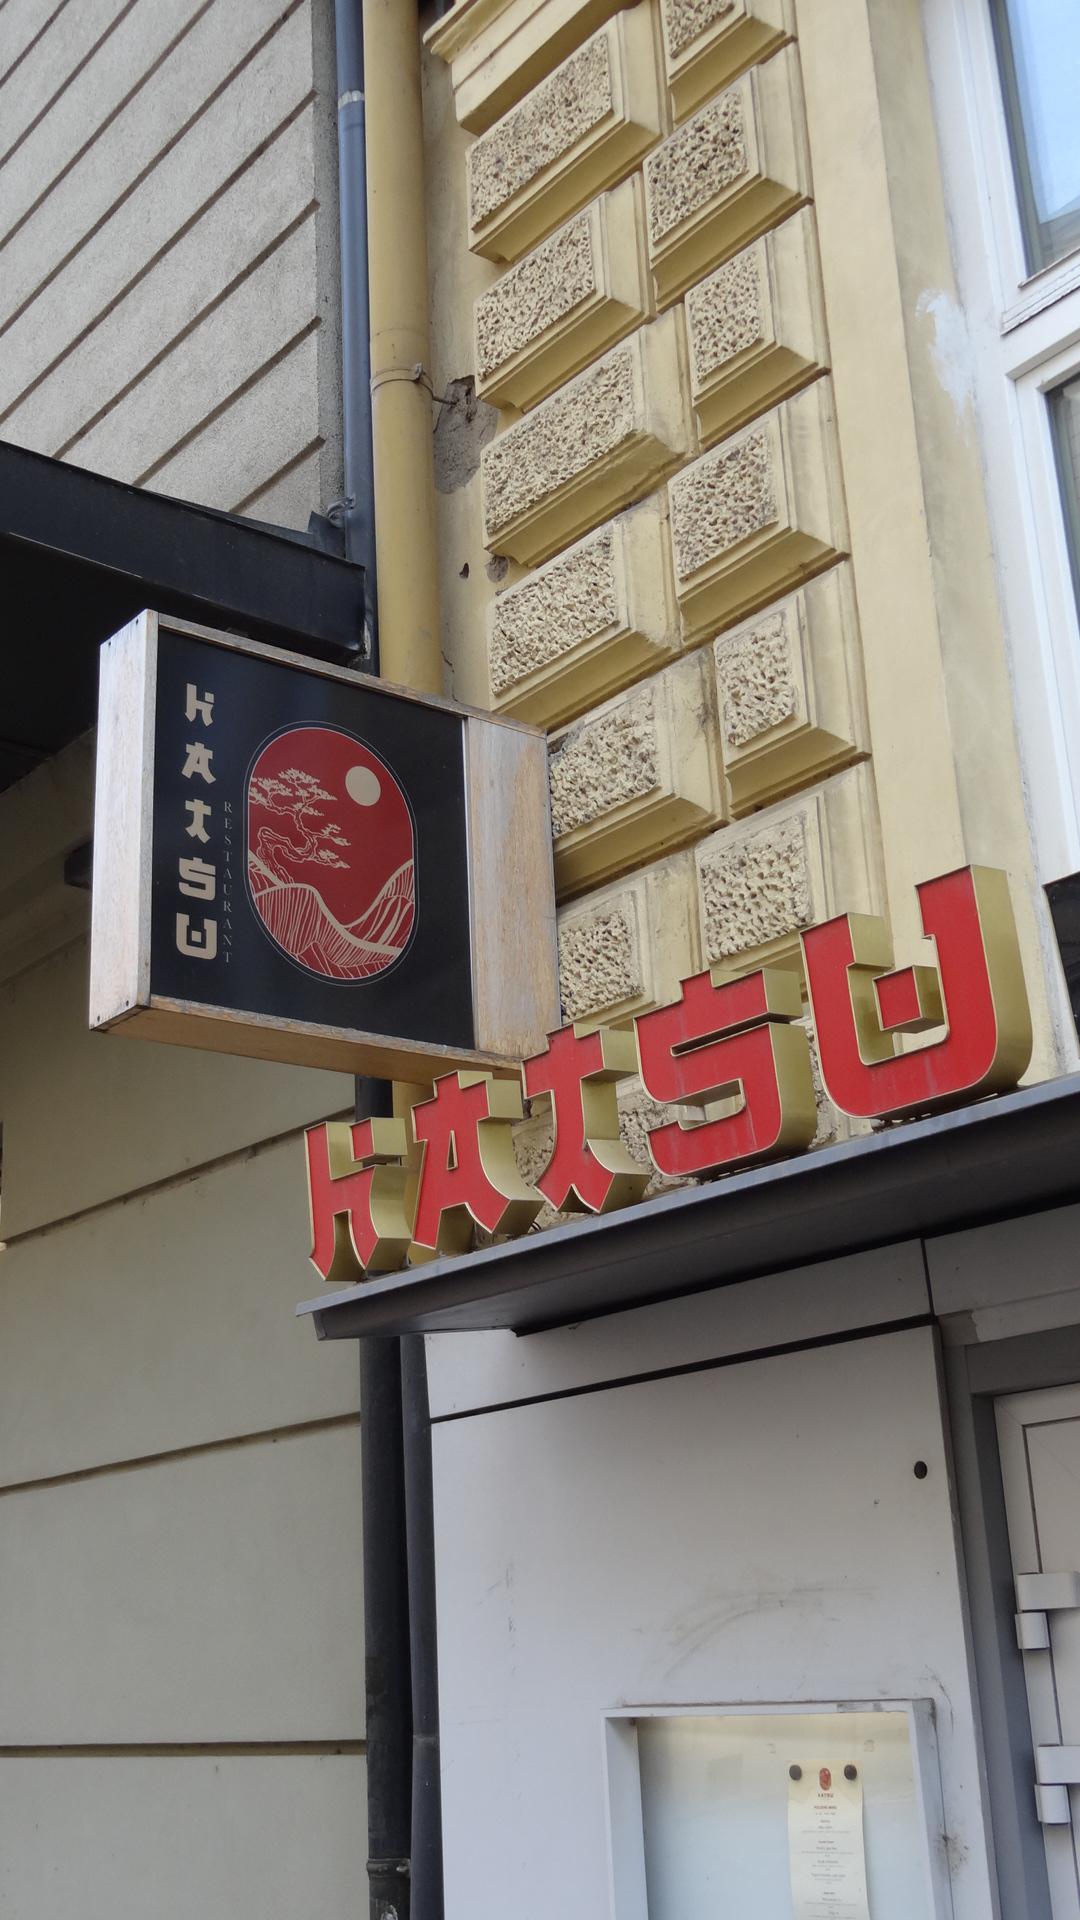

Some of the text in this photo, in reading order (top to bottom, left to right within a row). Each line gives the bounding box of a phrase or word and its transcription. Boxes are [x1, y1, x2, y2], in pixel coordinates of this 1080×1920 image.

[176, 683, 217, 960] KATSU
[223, 801, 233, 963] RESTAURANT
[304, 864, 1031, 1281] KATSU
